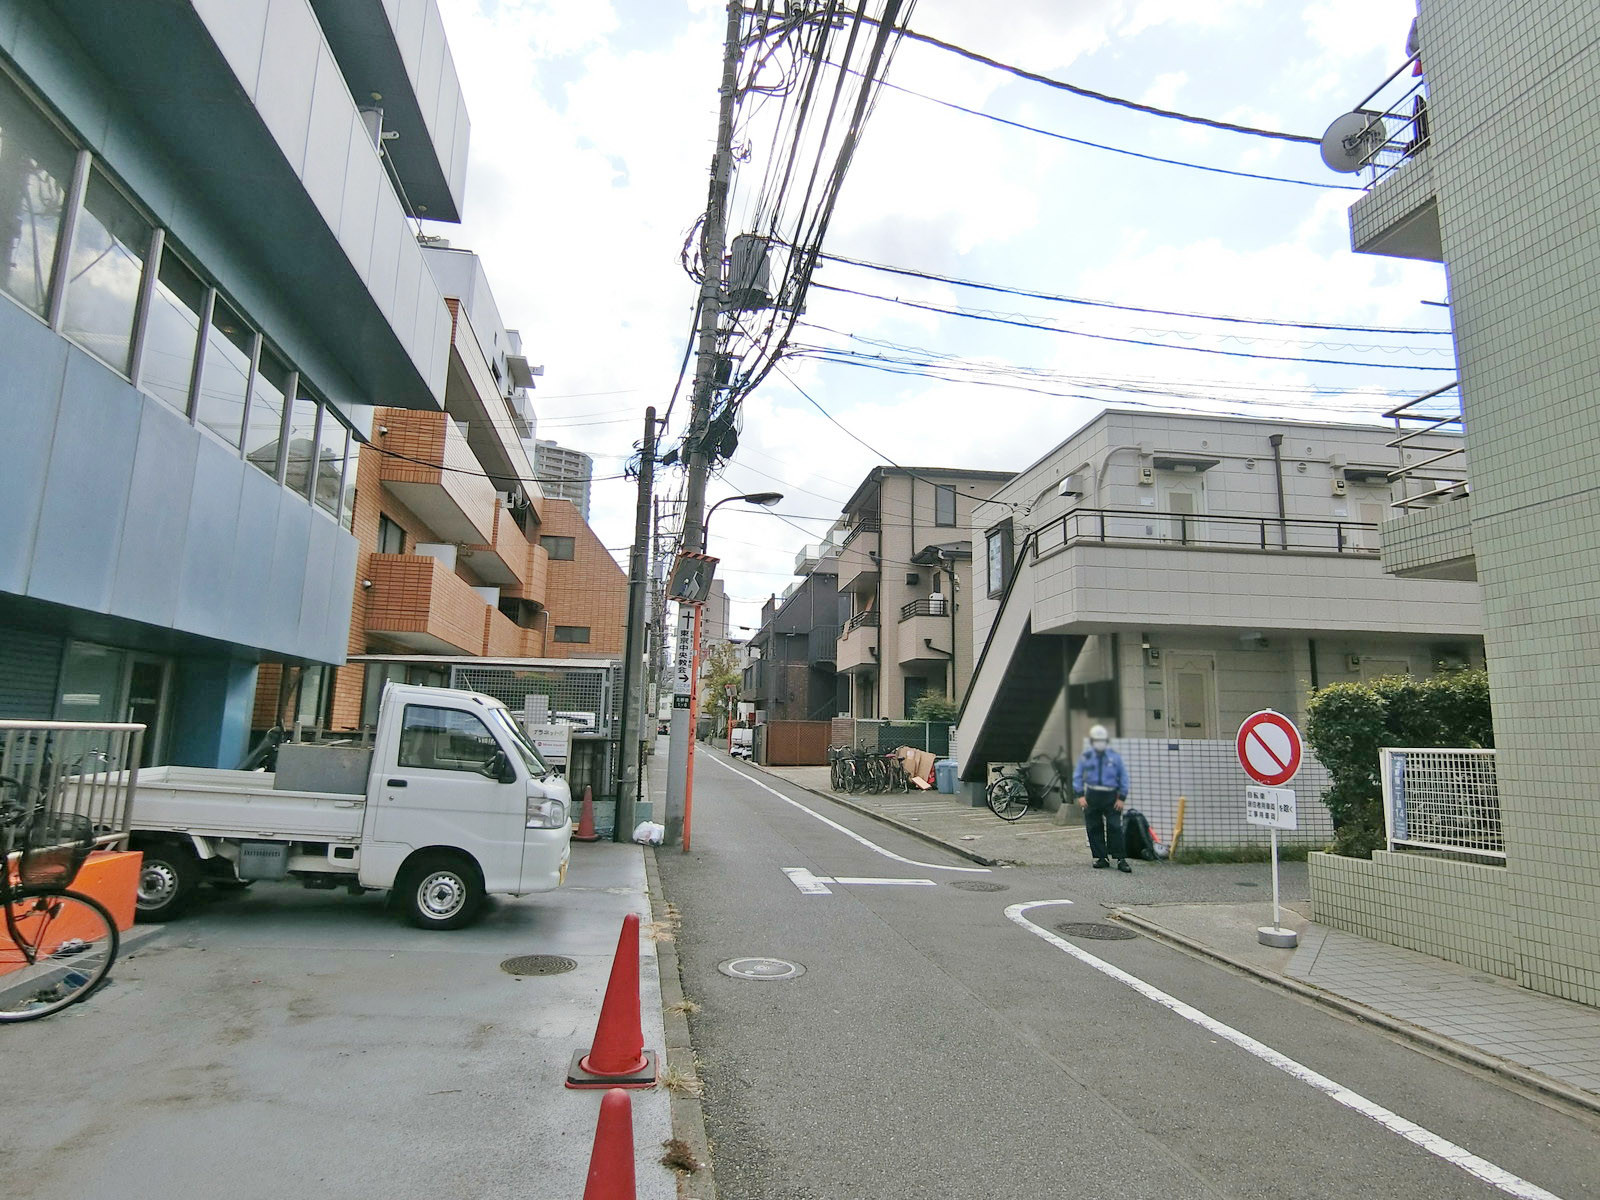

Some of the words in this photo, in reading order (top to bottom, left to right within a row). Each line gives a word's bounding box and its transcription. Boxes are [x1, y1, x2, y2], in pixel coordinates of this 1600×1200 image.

[678, 630, 690, 674] 東京中央教会
[1248, 810, 1276, 820] 工事用車両
